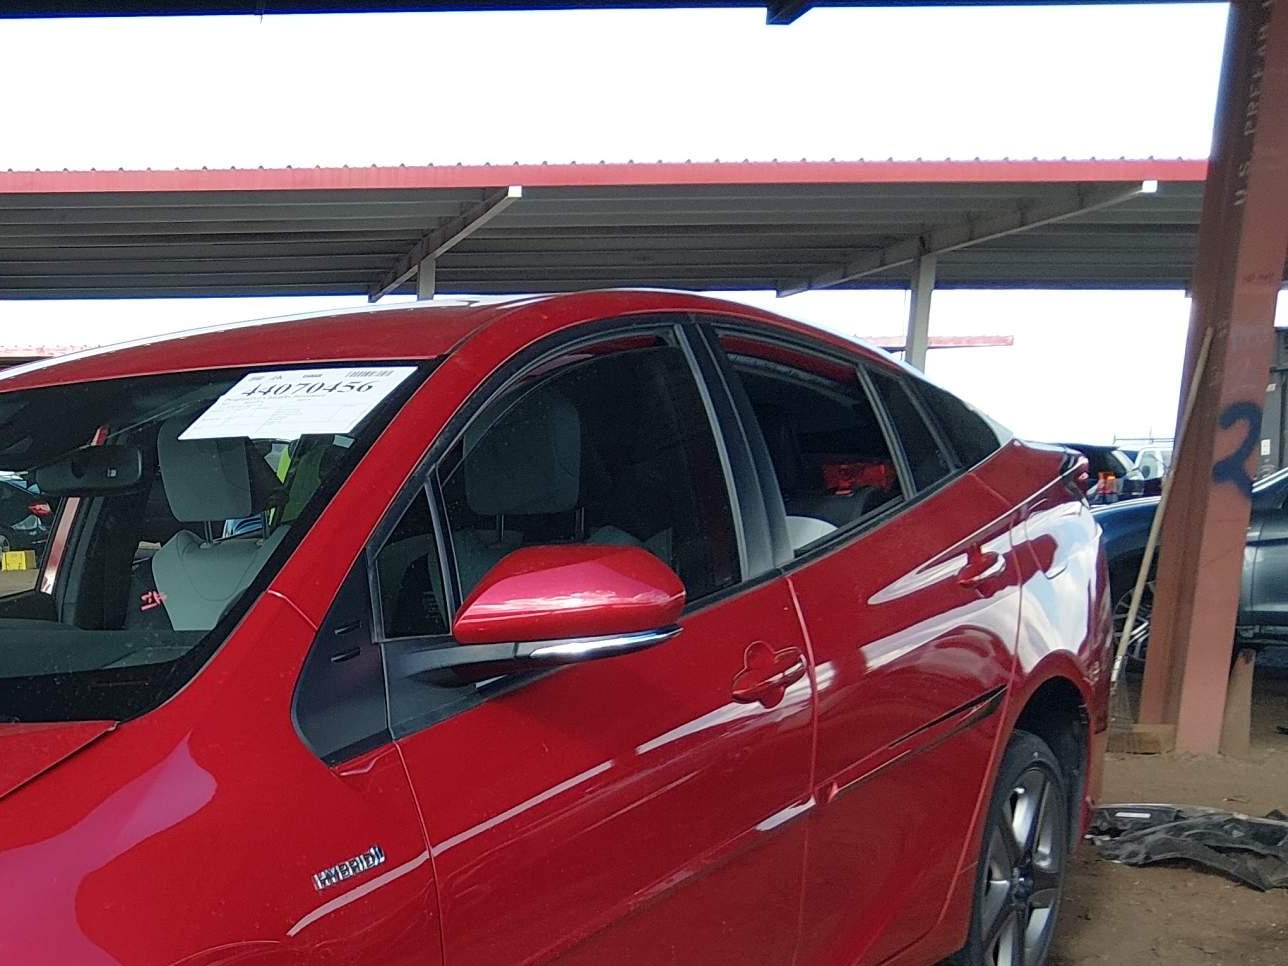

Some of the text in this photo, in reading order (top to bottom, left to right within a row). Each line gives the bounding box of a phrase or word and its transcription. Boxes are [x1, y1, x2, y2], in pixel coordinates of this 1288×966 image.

[241, 380, 380, 397] 44070456
[1213, 401, 1262, 499] 2
[313, 845, 386, 891] HYBRID
